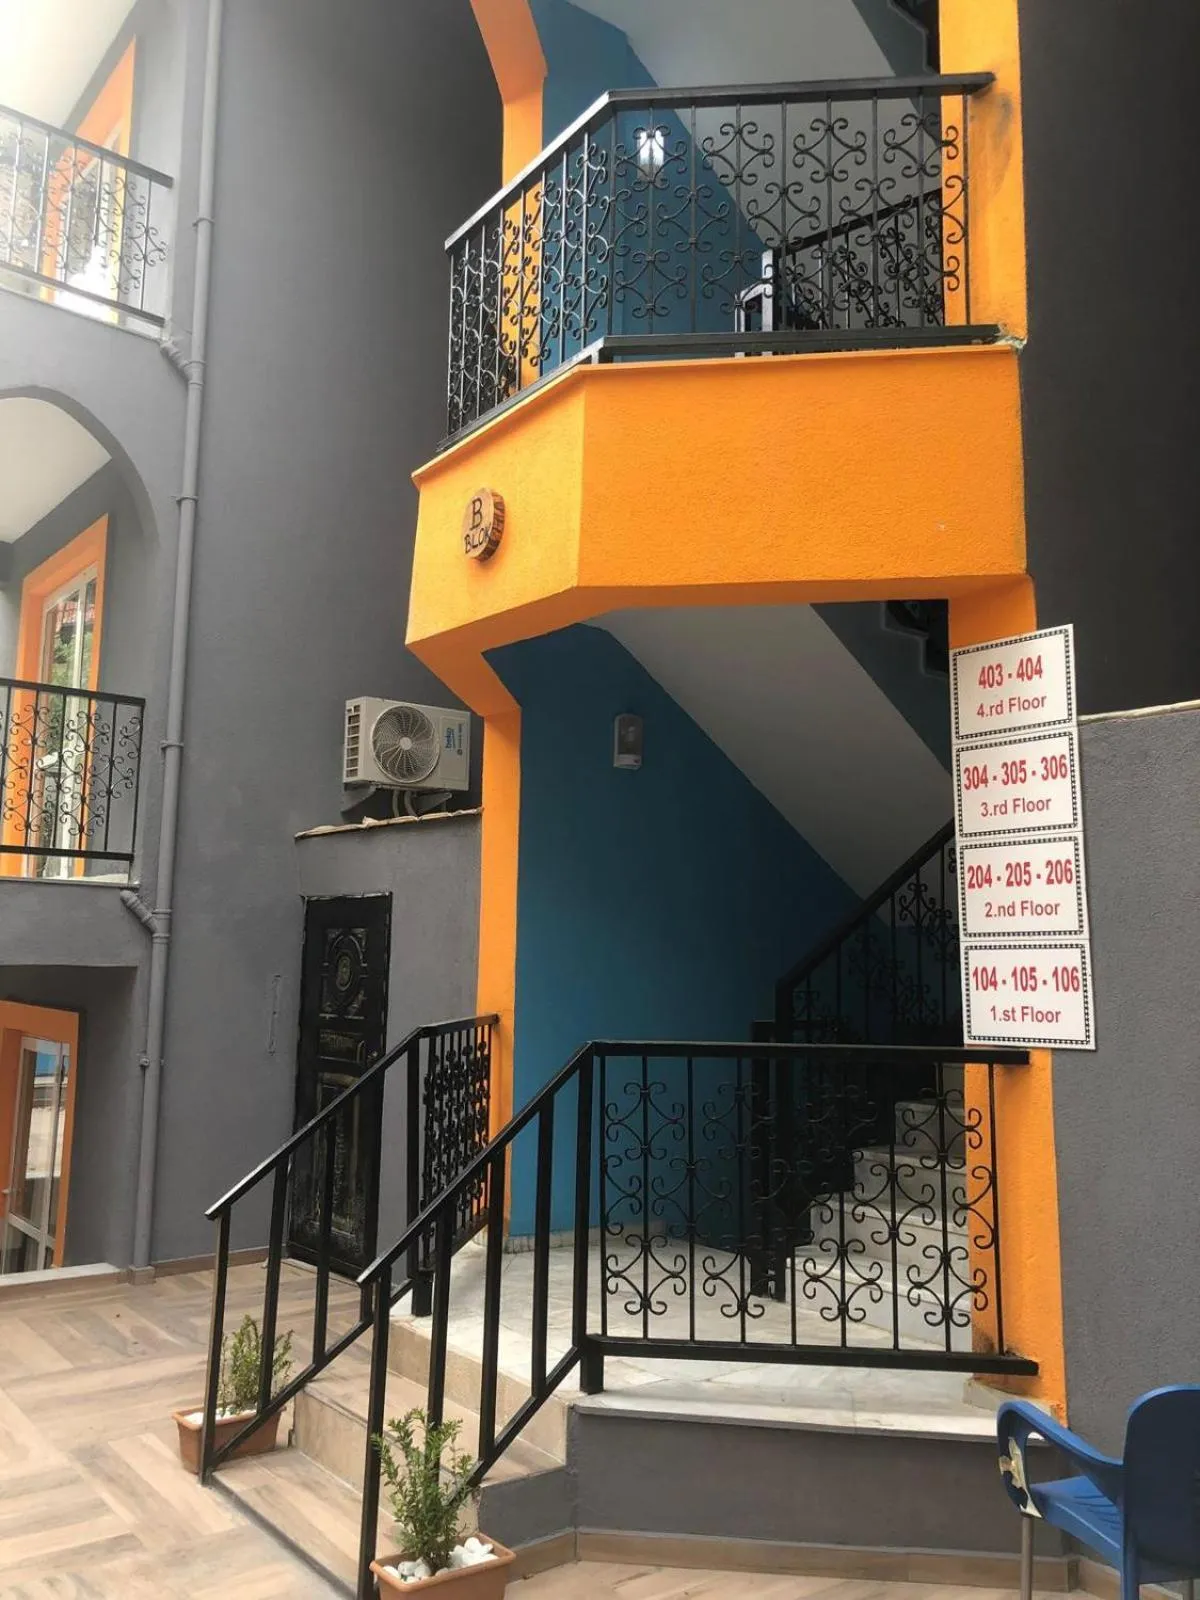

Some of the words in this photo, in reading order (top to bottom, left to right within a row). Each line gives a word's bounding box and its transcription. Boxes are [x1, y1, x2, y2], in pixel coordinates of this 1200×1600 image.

[469, 497, 483, 531] B
[978, 663, 1004, 689] 403
[1016, 655, 1043, 682] 404
[976, 699, 1004, 718] 4.rd
[1009, 694, 1047, 714] Floor
[963, 764, 989, 791] 304
[1001, 760, 1027, 786] 305
[1040, 754, 1068, 781] 306
[980, 799, 1008, 818] 3.rd
[1012, 796, 1052, 815] Floor
[967, 864, 993, 890] 204
[1005, 861, 1032, 887] 205
[1045, 858, 1073, 886] 206
[984, 900, 1016, 918] 2.nd
[1020, 899, 1060, 917] Floor
[972, 966, 998, 992] 104
[1011, 966, 1038, 992] 105
[1052, 965, 1080, 993] 106
[990, 1005, 1017, 1022] 1.st
[1021, 1006, 1061, 1023] Floor
